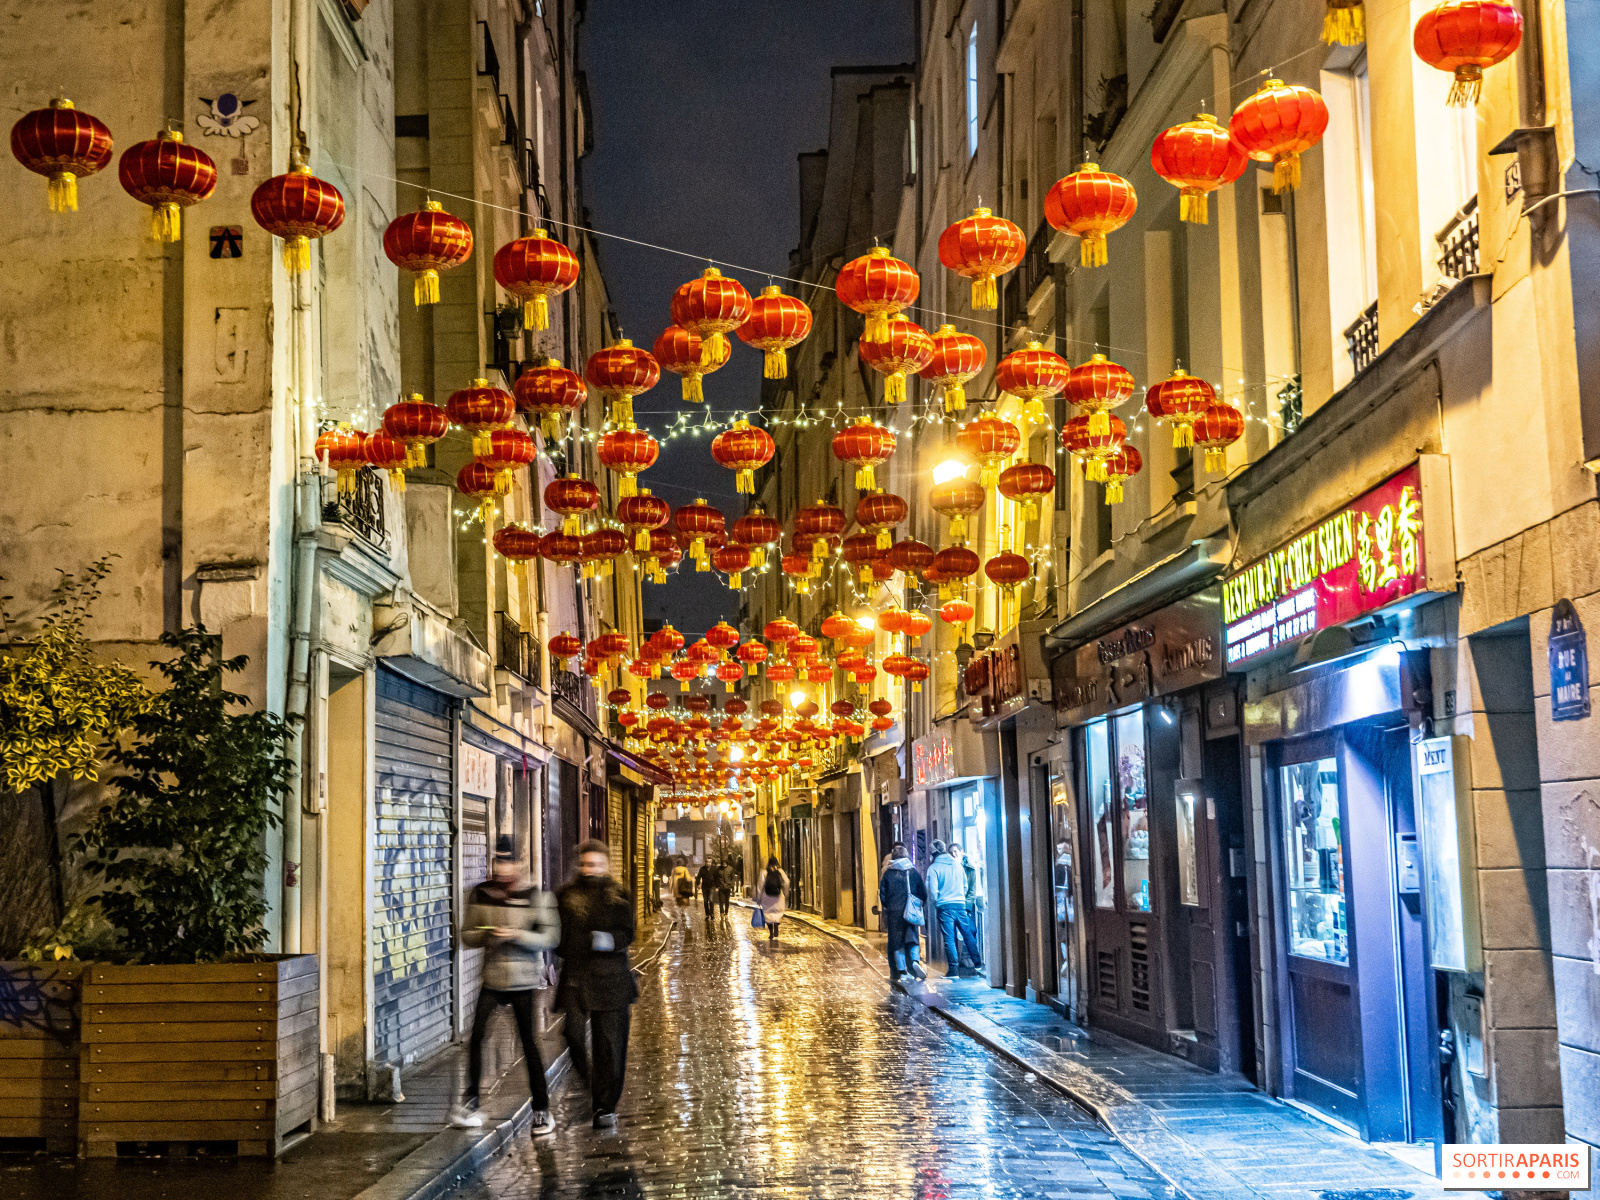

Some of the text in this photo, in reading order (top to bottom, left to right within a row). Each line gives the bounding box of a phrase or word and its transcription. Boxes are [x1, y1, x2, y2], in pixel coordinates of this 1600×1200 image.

[1507, 162, 1521, 195] 39
[1223, 551, 1287, 625] RESTAURANT
[1288, 530, 1318, 590] CHEZ
[1319, 510, 1353, 574] SHEN
[1558, 649, 1576, 669] RUE
[1557, 683, 1581, 703] MAIRE
[1424, 748, 1446, 767] MENU
